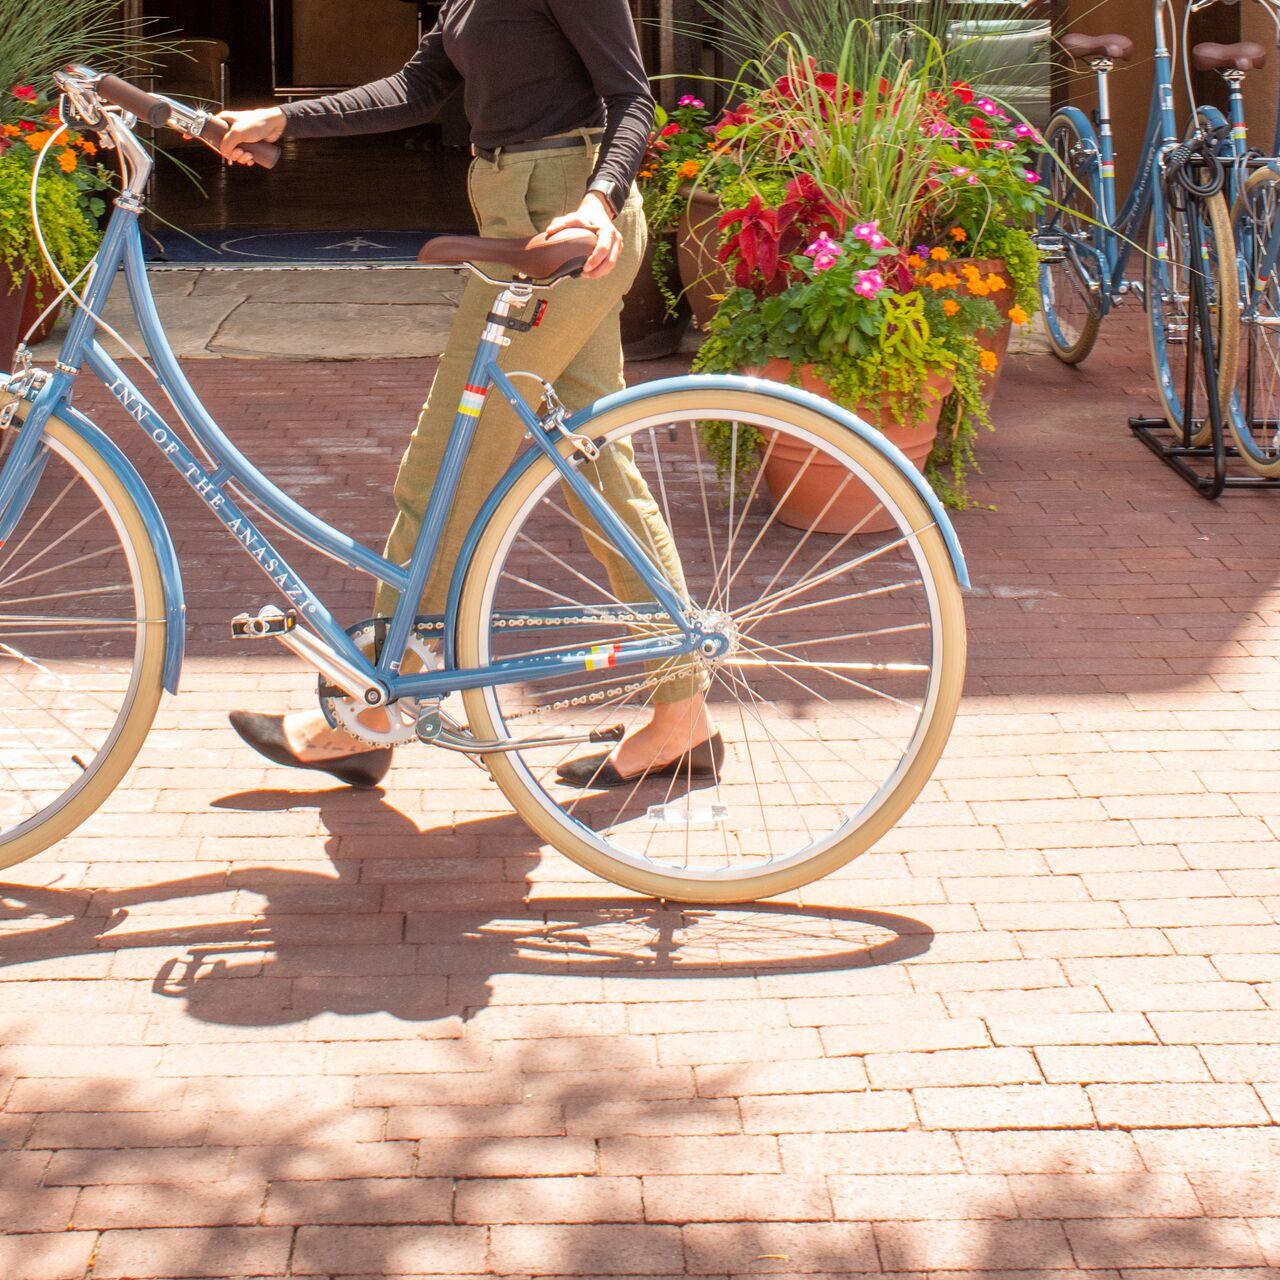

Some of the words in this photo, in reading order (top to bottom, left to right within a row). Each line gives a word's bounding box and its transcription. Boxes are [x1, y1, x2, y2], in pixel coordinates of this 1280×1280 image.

[109, 377, 150, 423] INN
[152, 427, 180, 455] OF
[184, 462, 226, 511] THE
